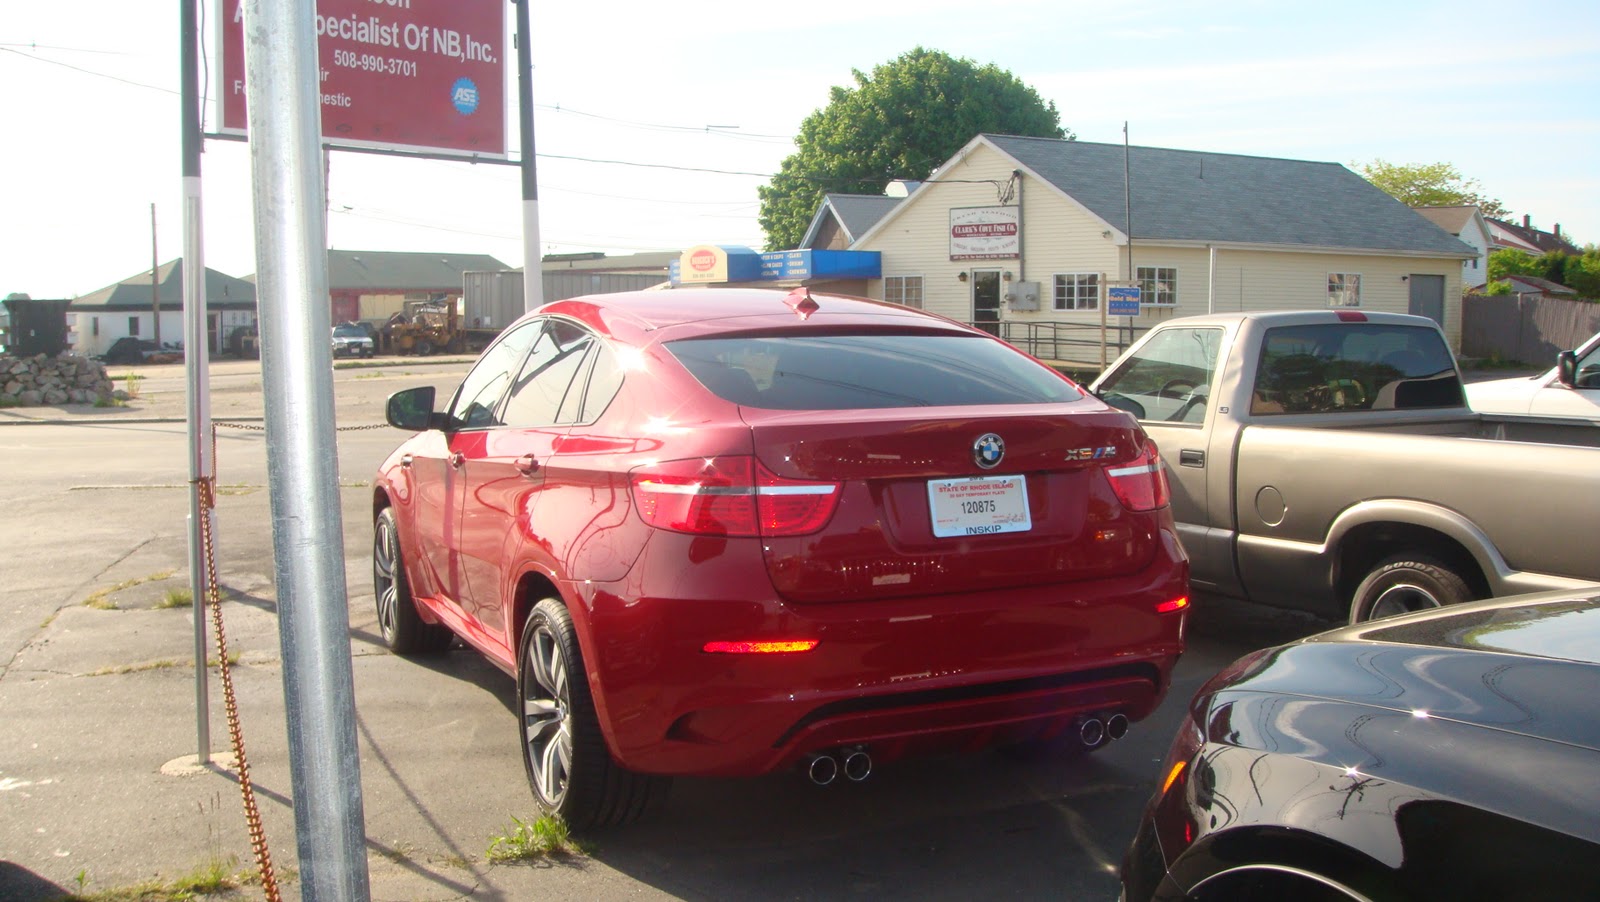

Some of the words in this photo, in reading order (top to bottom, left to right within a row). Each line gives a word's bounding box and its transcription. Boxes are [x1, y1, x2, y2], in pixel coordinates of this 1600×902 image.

[317, 14, 400, 48] pecialist
[404, 23, 429, 51] Of
[433, 28, 497, 63] NB,Inc.
[334, 49, 417, 77] 508-990-3701
[454, 87, 476, 103] ASE
[955, 225, 978, 234] CLARK'S
[979, 224, 992, 233] COVE
[993, 224, 1006, 232] FISH
[961, 500, 996, 514] 120875
[965, 524, 1002, 534] INSKIP
